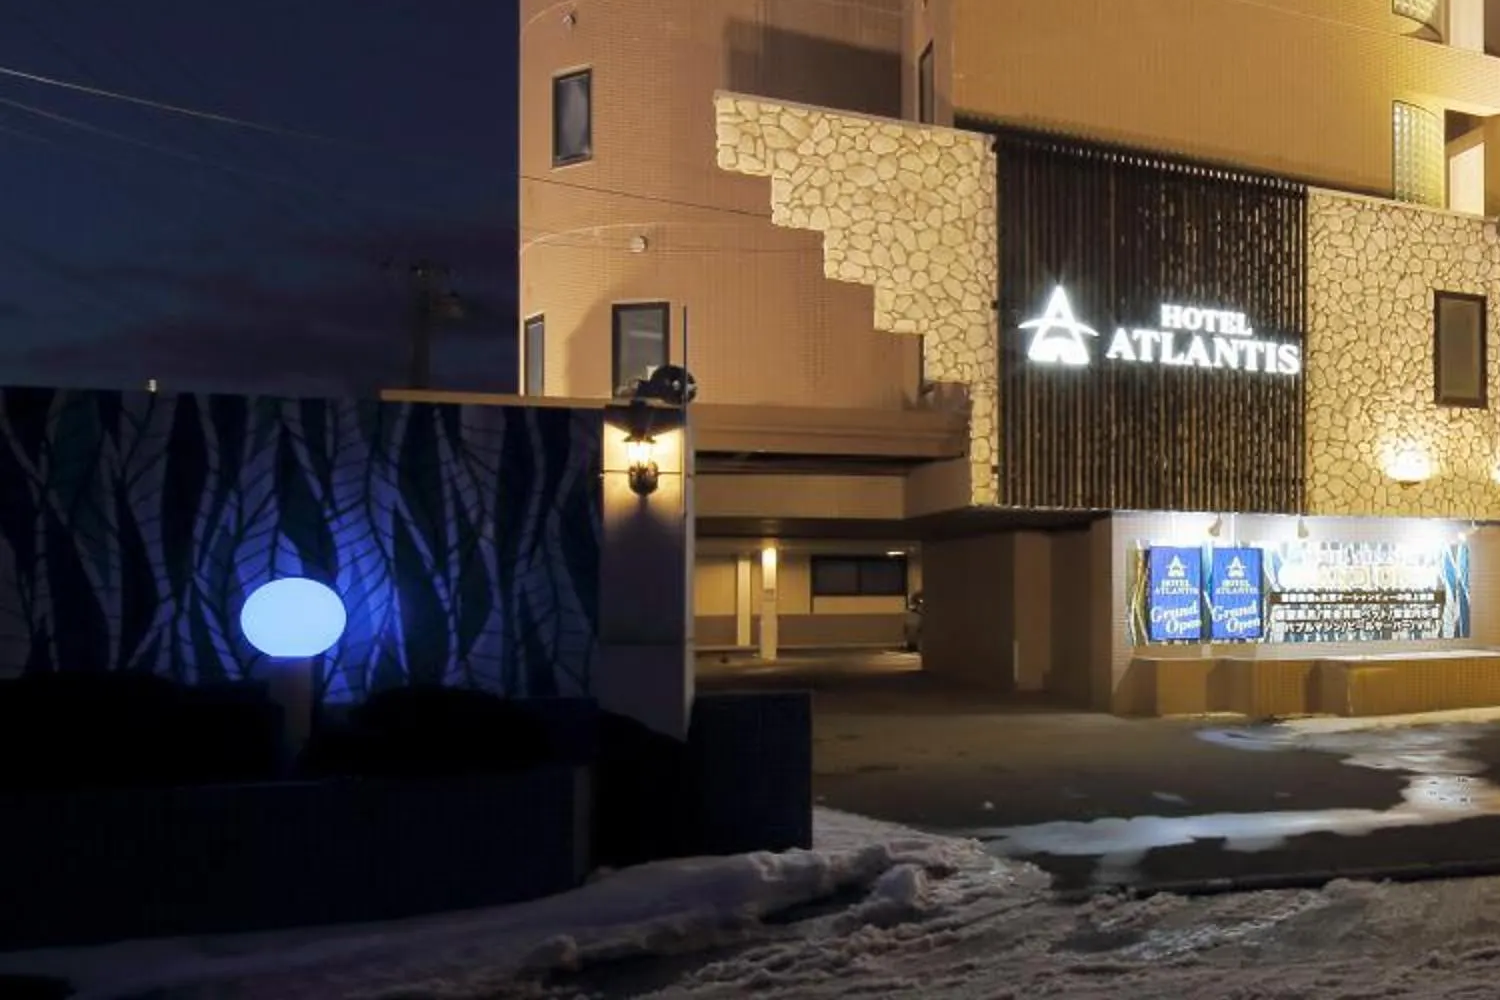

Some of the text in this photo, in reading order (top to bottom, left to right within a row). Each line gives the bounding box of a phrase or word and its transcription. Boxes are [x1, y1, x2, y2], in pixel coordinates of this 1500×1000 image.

[1160, 303, 1253, 336] HOTEL
[1105, 327, 1300, 375] ATLANTIS
[1150, 600, 1198, 622] Grand
[1212, 599, 1258, 622] Grand
[1166, 618, 1202, 634] Open
[1226, 617, 1261, 633] Open
